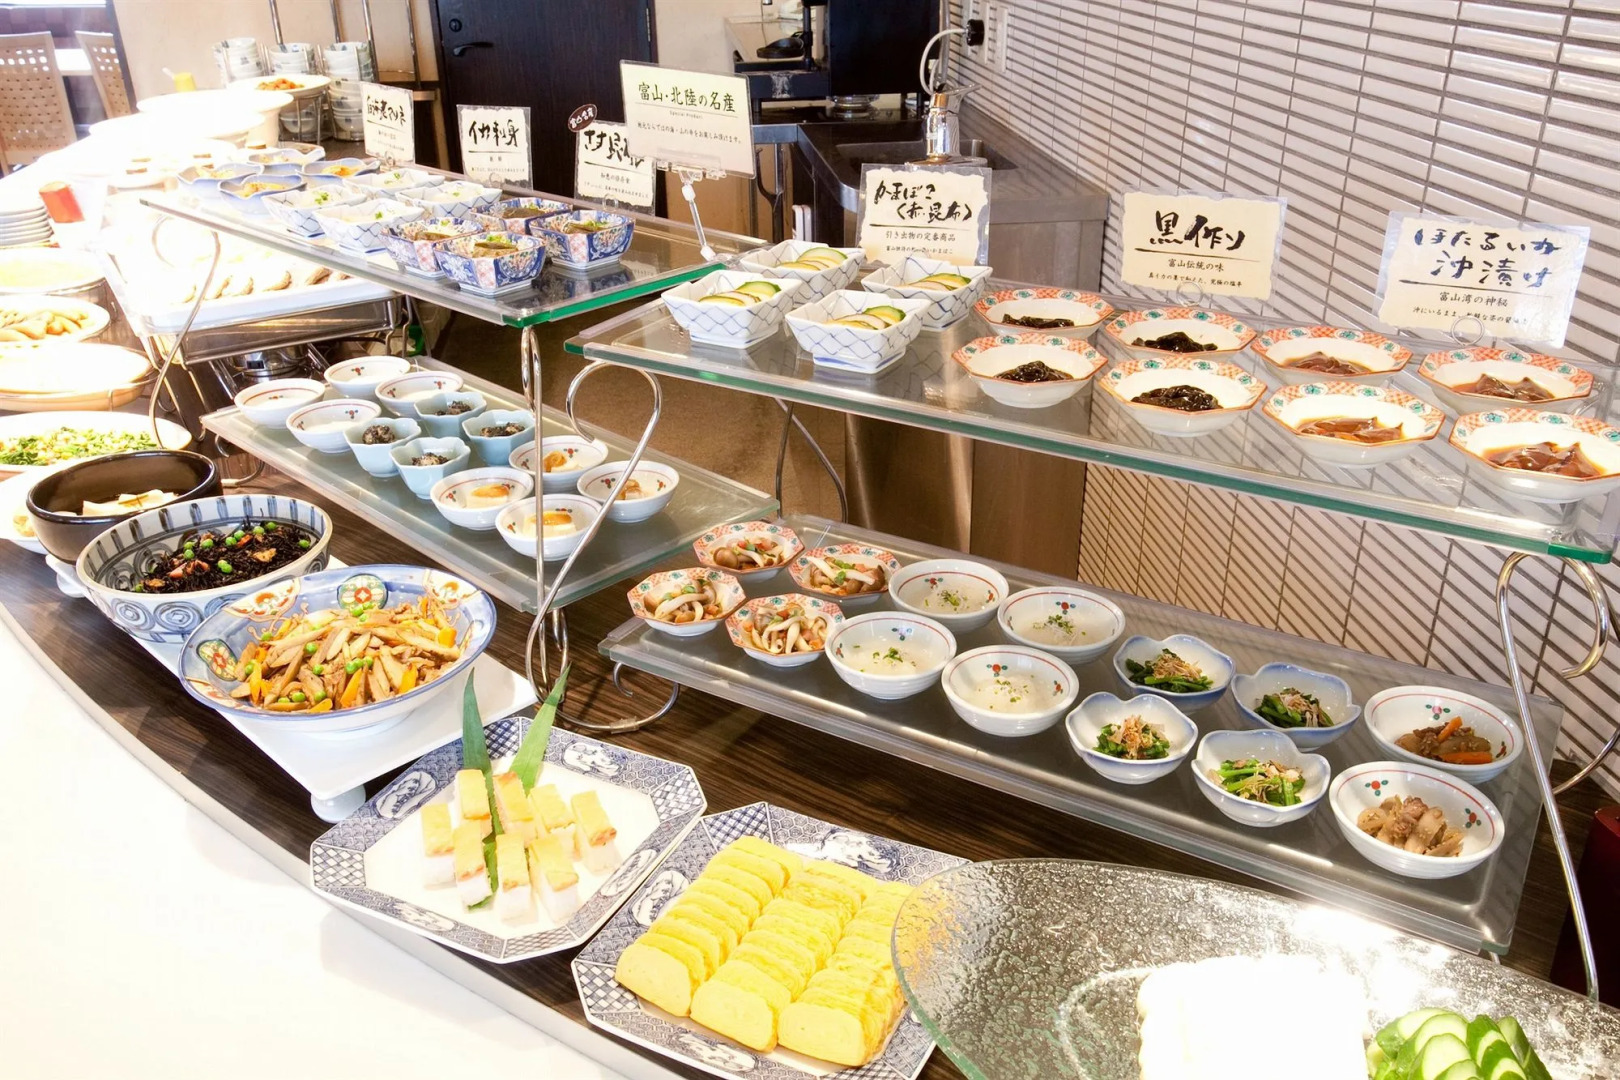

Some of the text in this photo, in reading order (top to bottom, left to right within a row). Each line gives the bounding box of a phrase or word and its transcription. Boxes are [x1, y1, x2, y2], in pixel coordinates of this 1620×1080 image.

[874, 180, 936, 204] かまぼこ
[1149, 210, 1245, 250] 黒作り
[1414, 228, 1561, 255] ほたるいか
[1168, 258, 1224, 272] 富山伝統の味
[1430, 250, 1552, 289] 沖漬け
[1439, 291, 1508, 307] 富山湾の神秘
